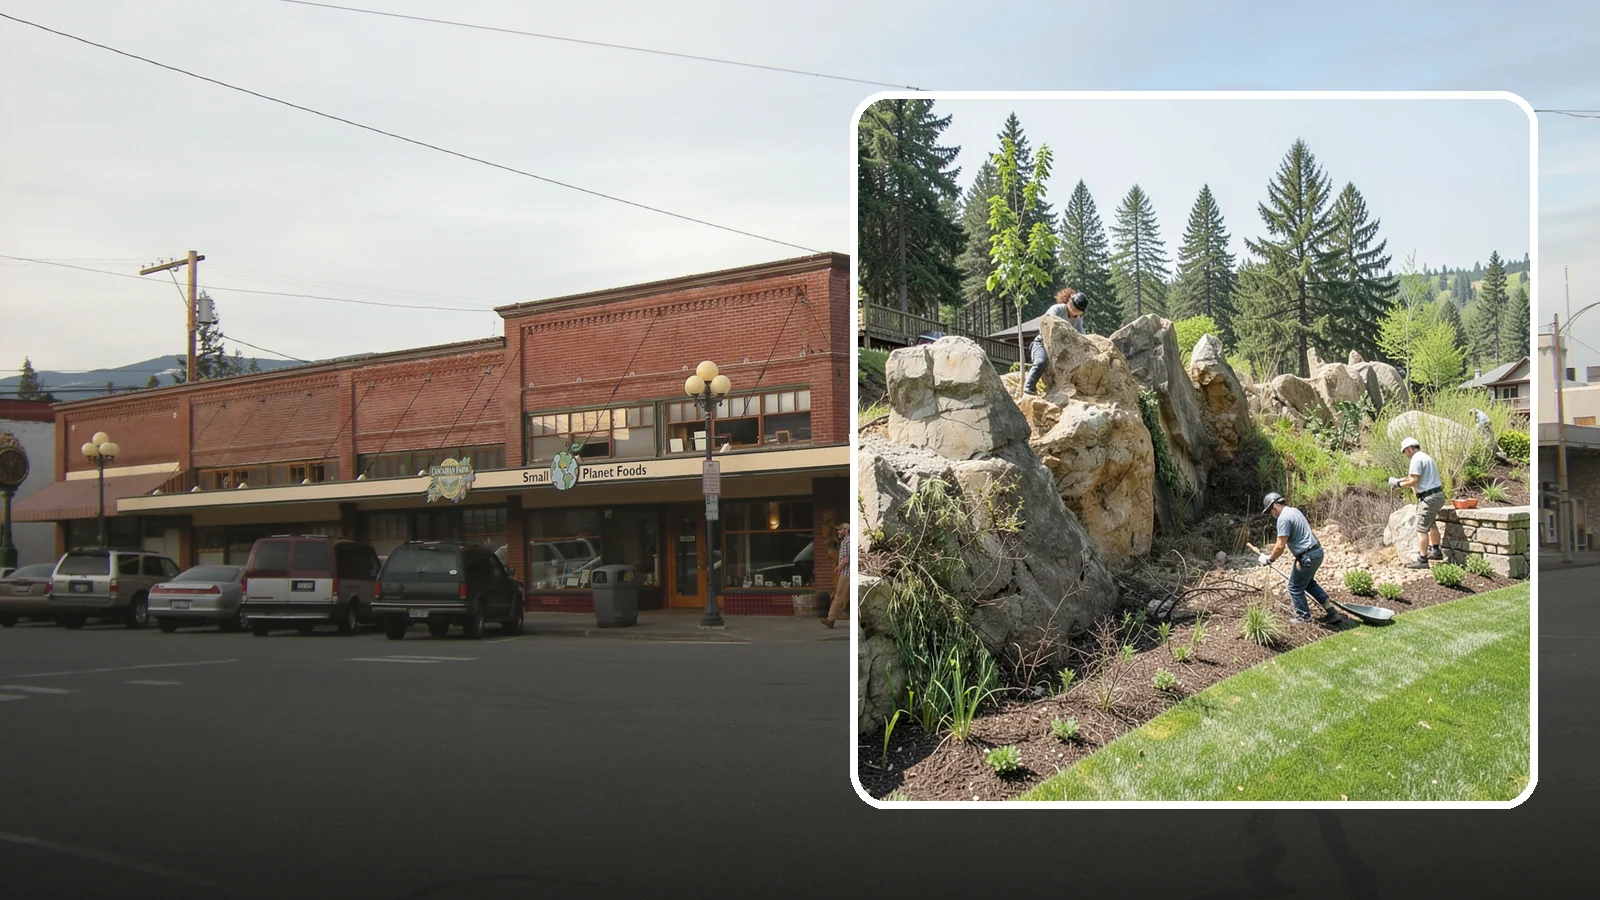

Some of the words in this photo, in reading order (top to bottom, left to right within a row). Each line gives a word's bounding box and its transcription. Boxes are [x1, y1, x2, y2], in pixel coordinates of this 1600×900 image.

[523, 471, 549, 483] Small
[582, 467, 614, 480] Planet
[616, 463, 647, 477] Foods
